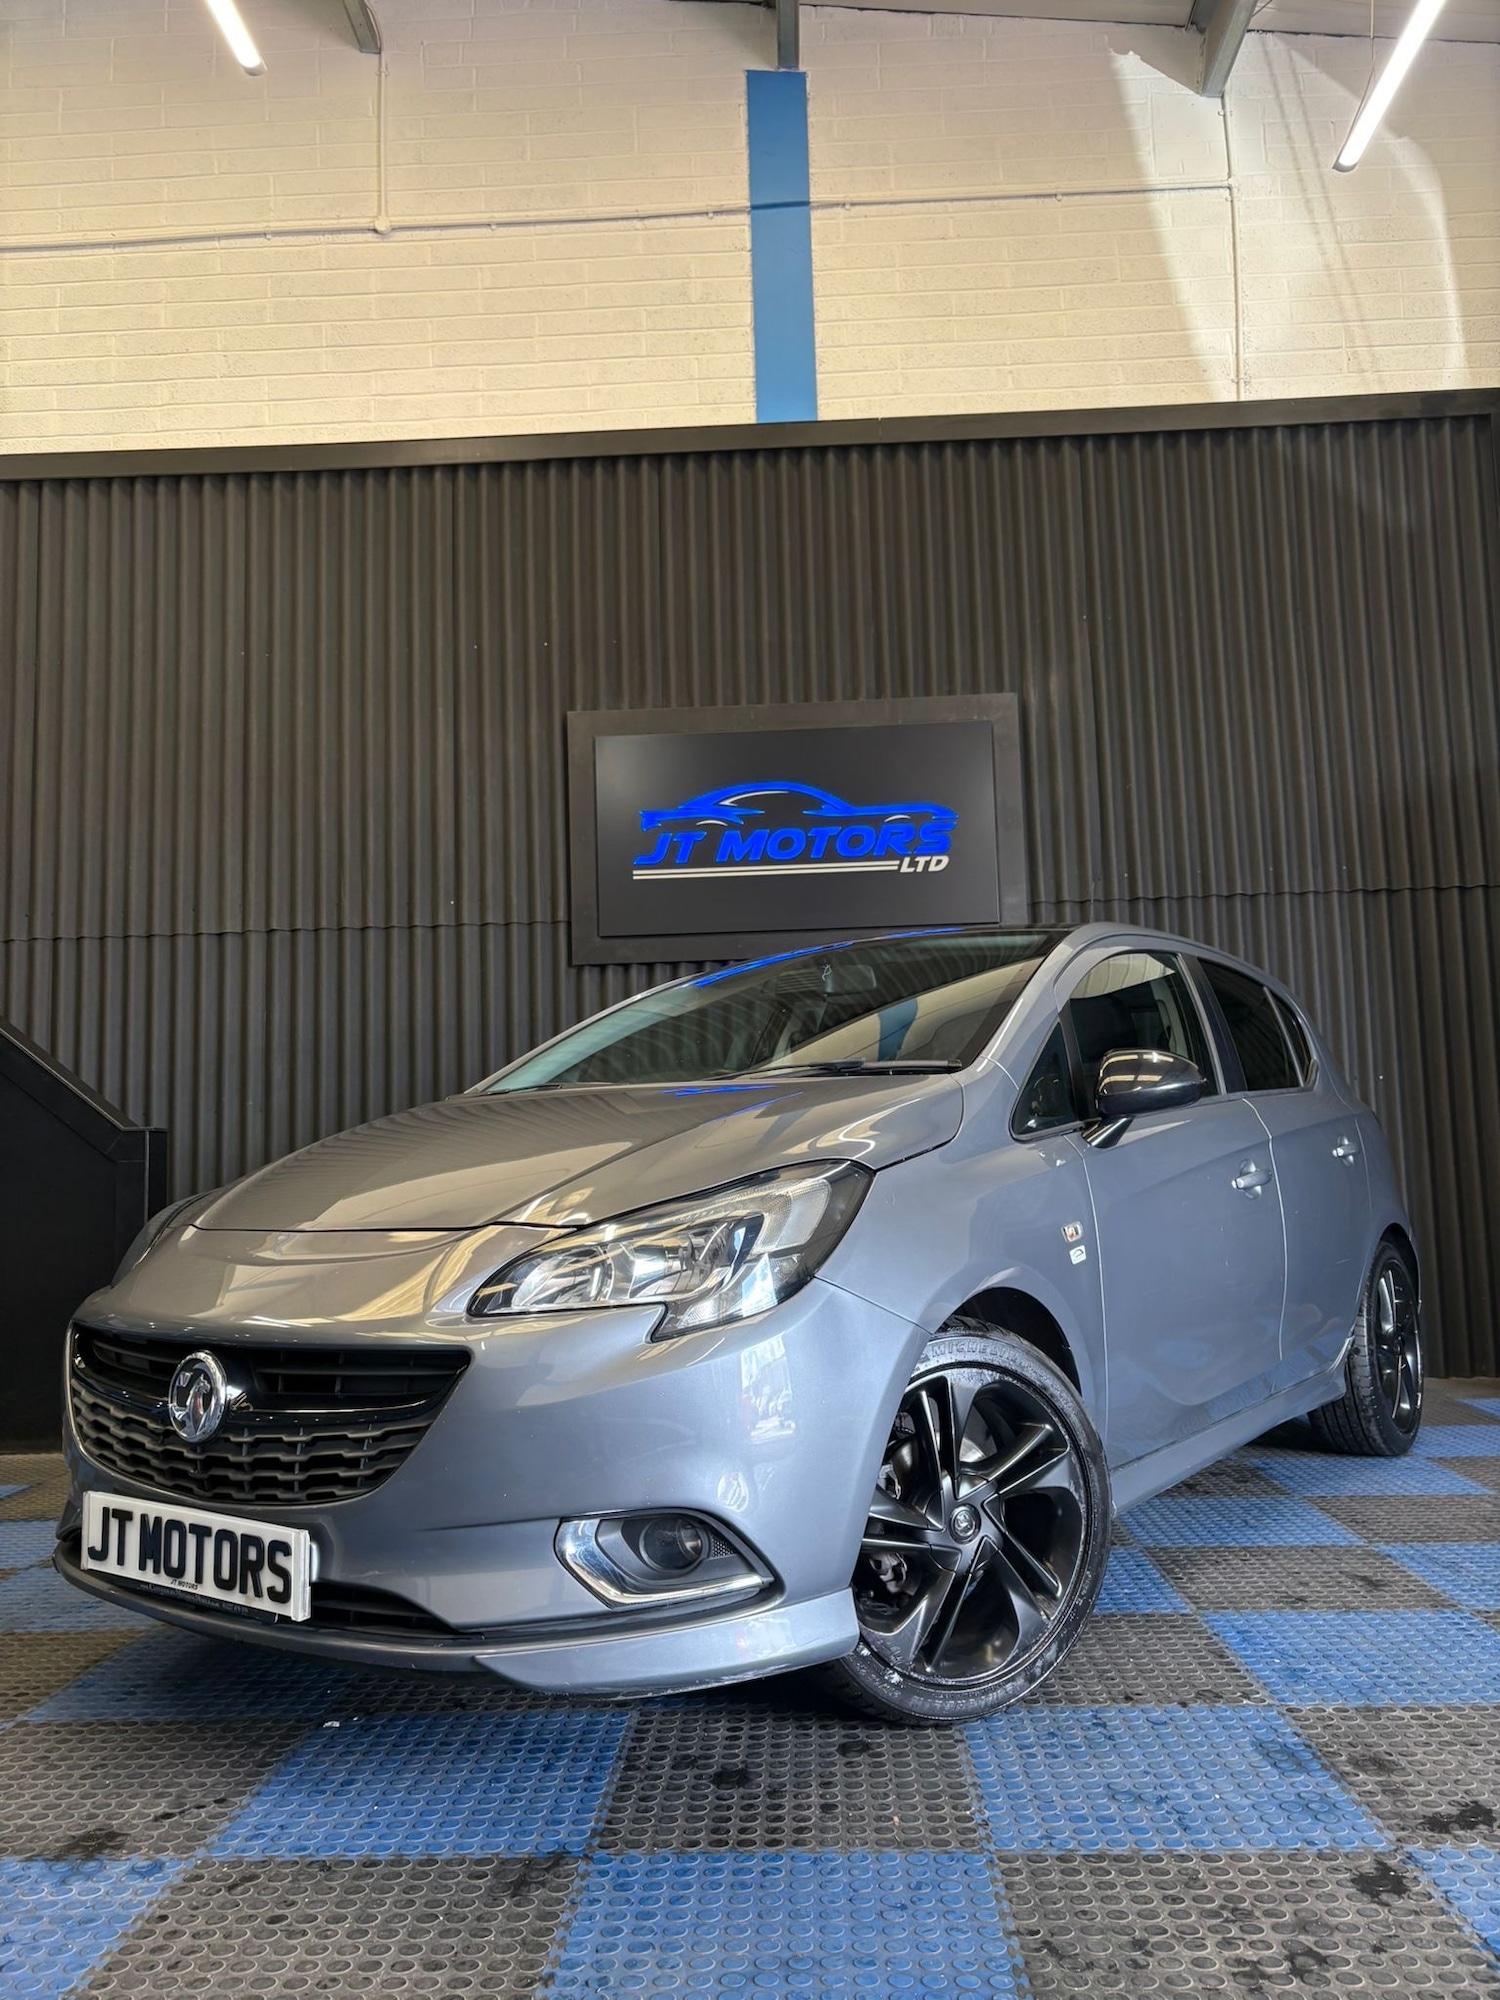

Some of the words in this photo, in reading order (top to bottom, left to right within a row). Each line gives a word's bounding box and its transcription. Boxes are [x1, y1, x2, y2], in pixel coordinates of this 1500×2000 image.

[633, 832, 707, 865] JT
[715, 822, 957, 862] MOTORS
[899, 855, 949, 873] LTD
[931, 1341, 1018, 1363] MICHELIN
[87, 1506, 133, 1566] JT
[138, 1513, 292, 1604] MOTORS
[179, 1581, 198, 1590] MOTORS
